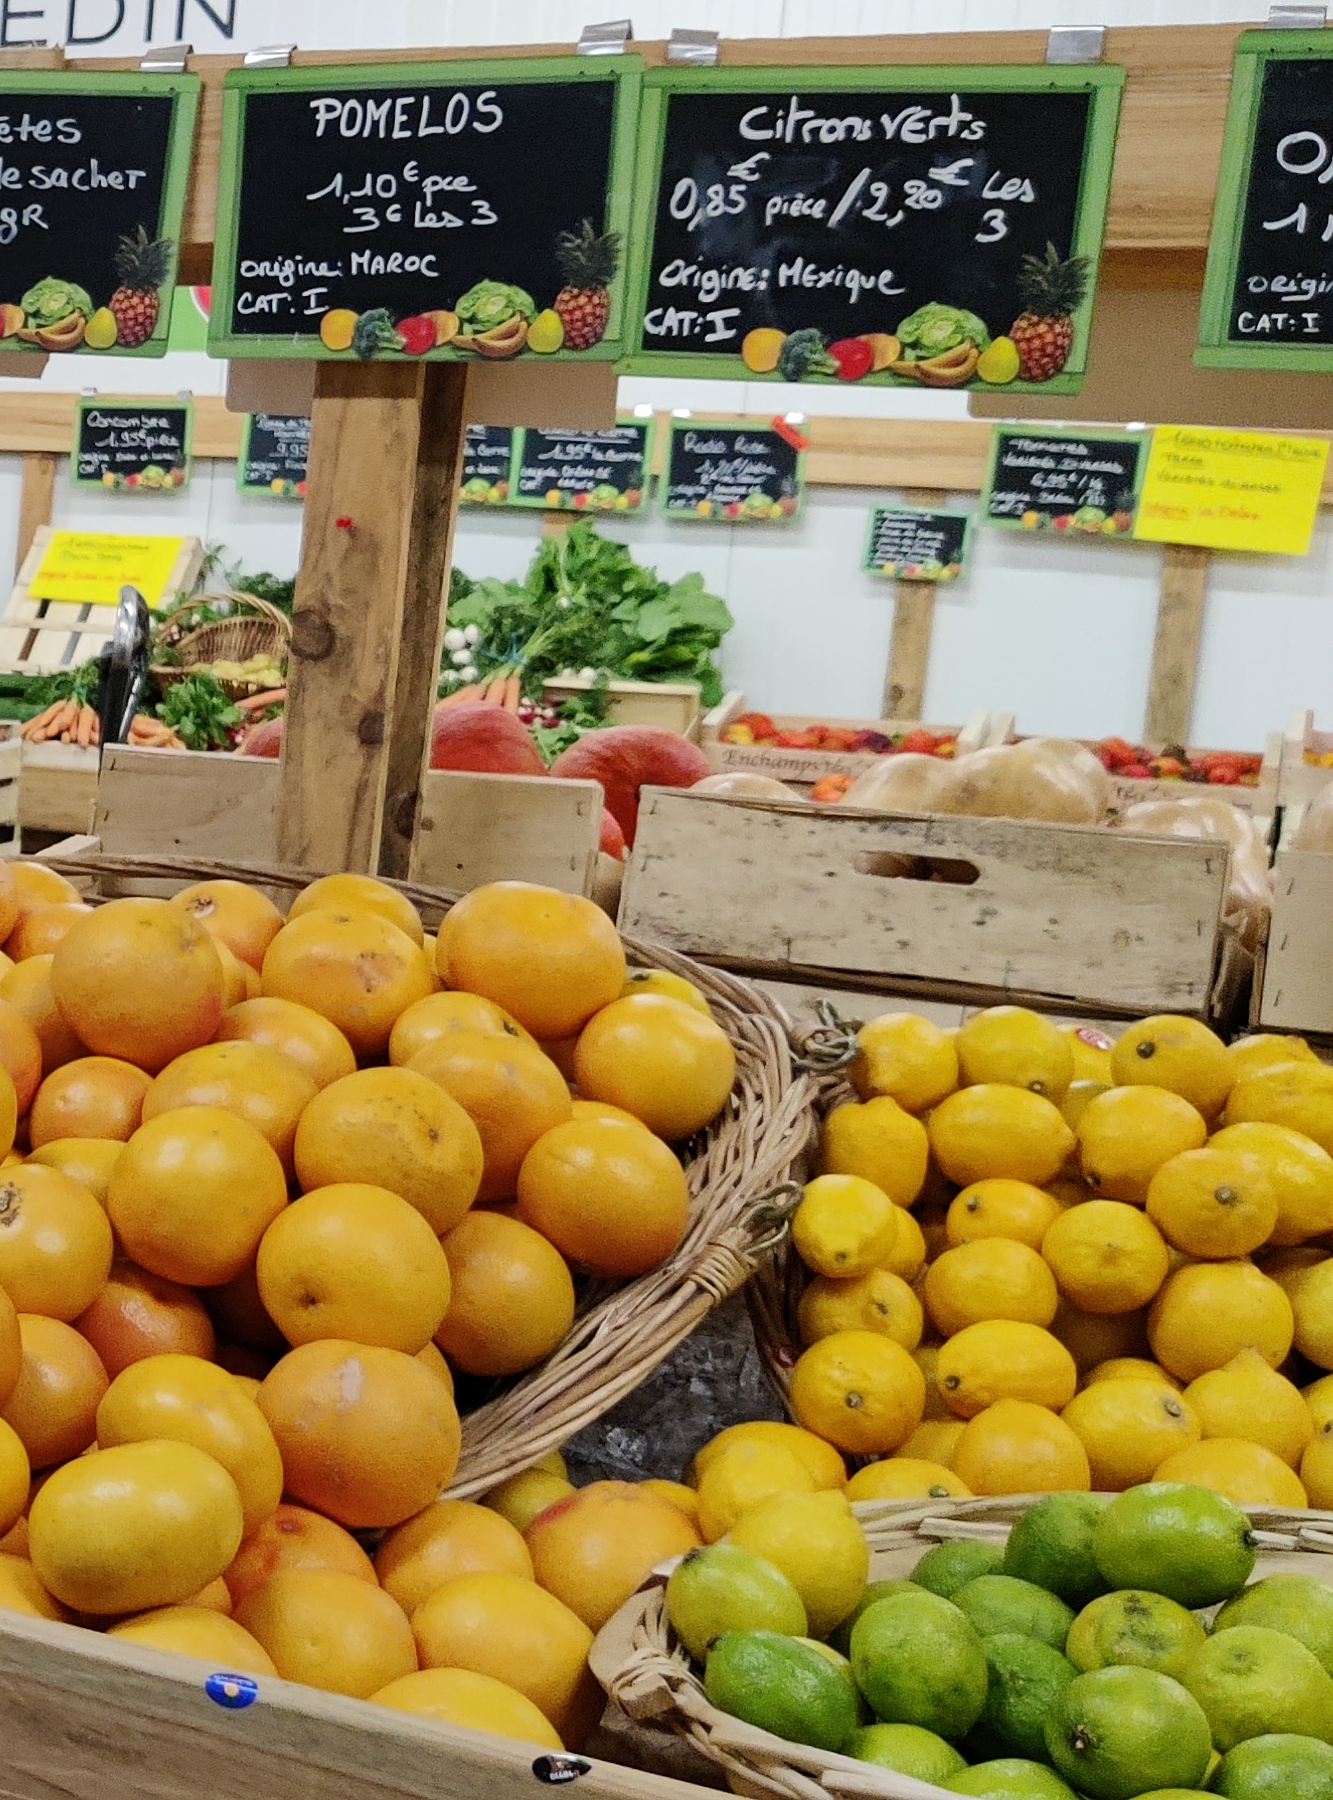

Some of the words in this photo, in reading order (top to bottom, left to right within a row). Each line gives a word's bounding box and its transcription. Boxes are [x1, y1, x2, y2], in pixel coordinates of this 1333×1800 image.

[309, 90, 505, 140] POMELOS
[738, 94, 872, 144] Citrons
[422, 173, 477, 207] pce
[471, 200, 498, 225] 3
[974, 208, 1010, 244] 3
[350, 249, 440, 277] MAROC
